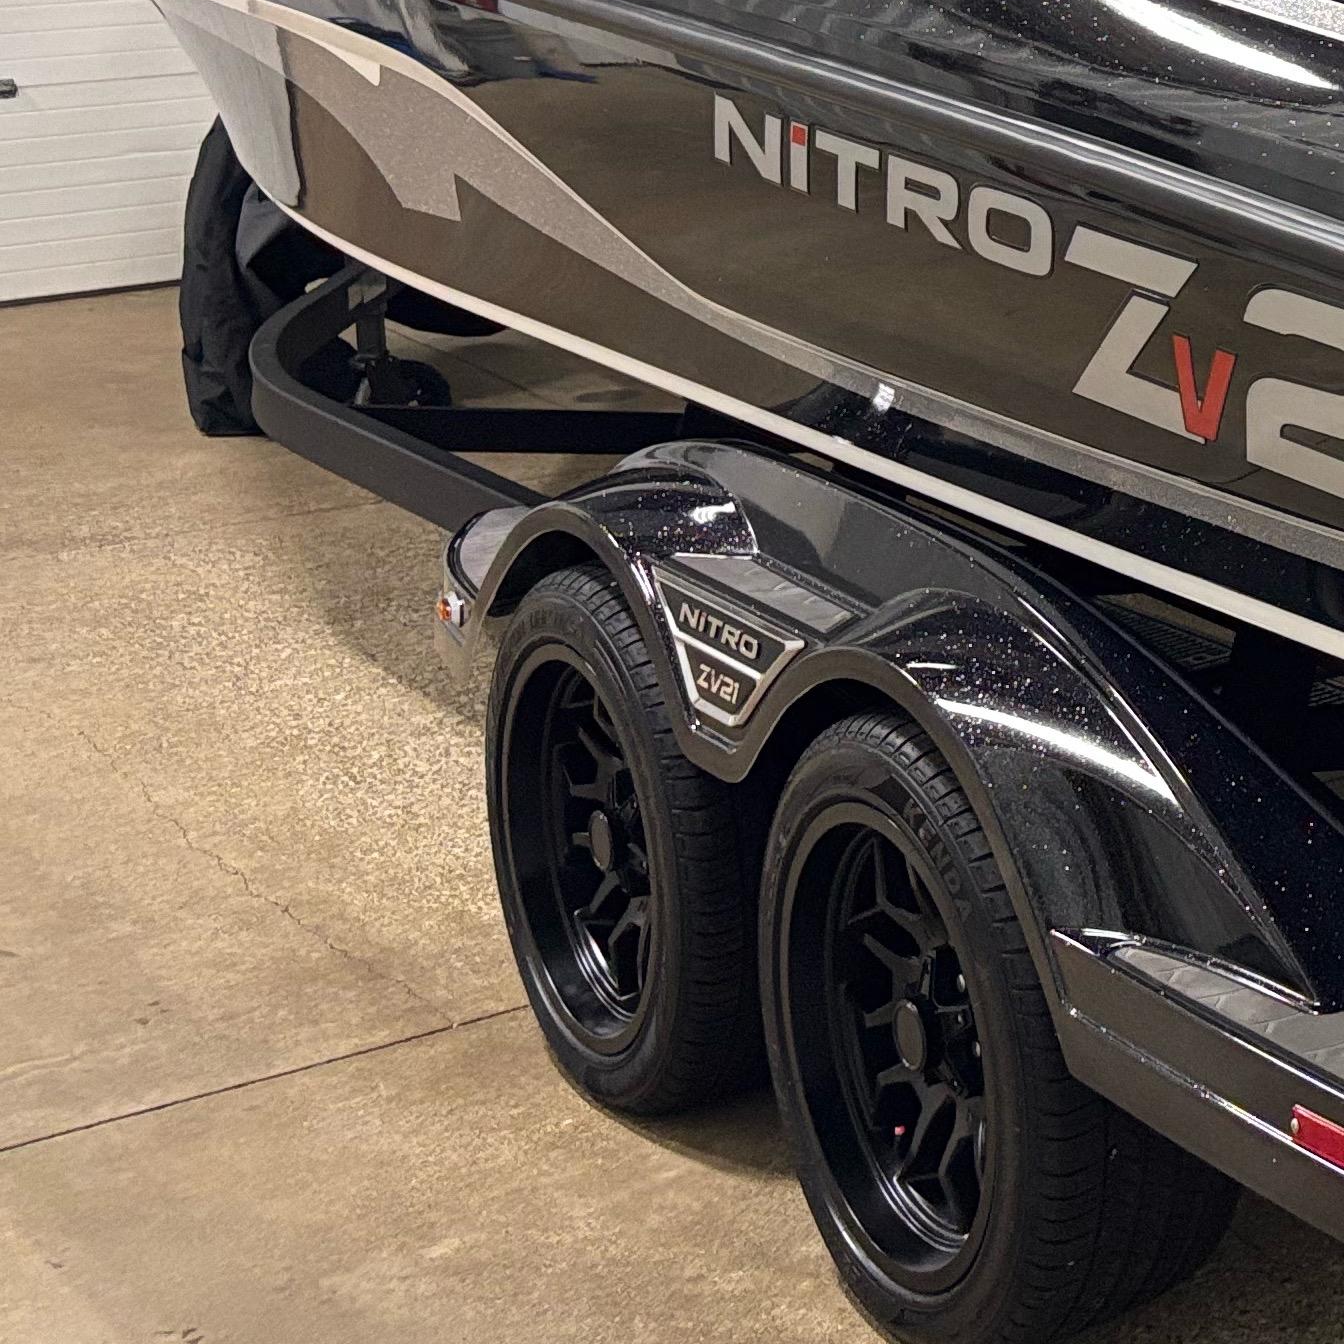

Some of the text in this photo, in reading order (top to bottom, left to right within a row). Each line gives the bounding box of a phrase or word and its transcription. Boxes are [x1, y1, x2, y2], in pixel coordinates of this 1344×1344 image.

[713, 92, 1056, 278] NITRO
[679, 602, 759, 659] NITRO
[697, 664, 740, 704] ZV21
